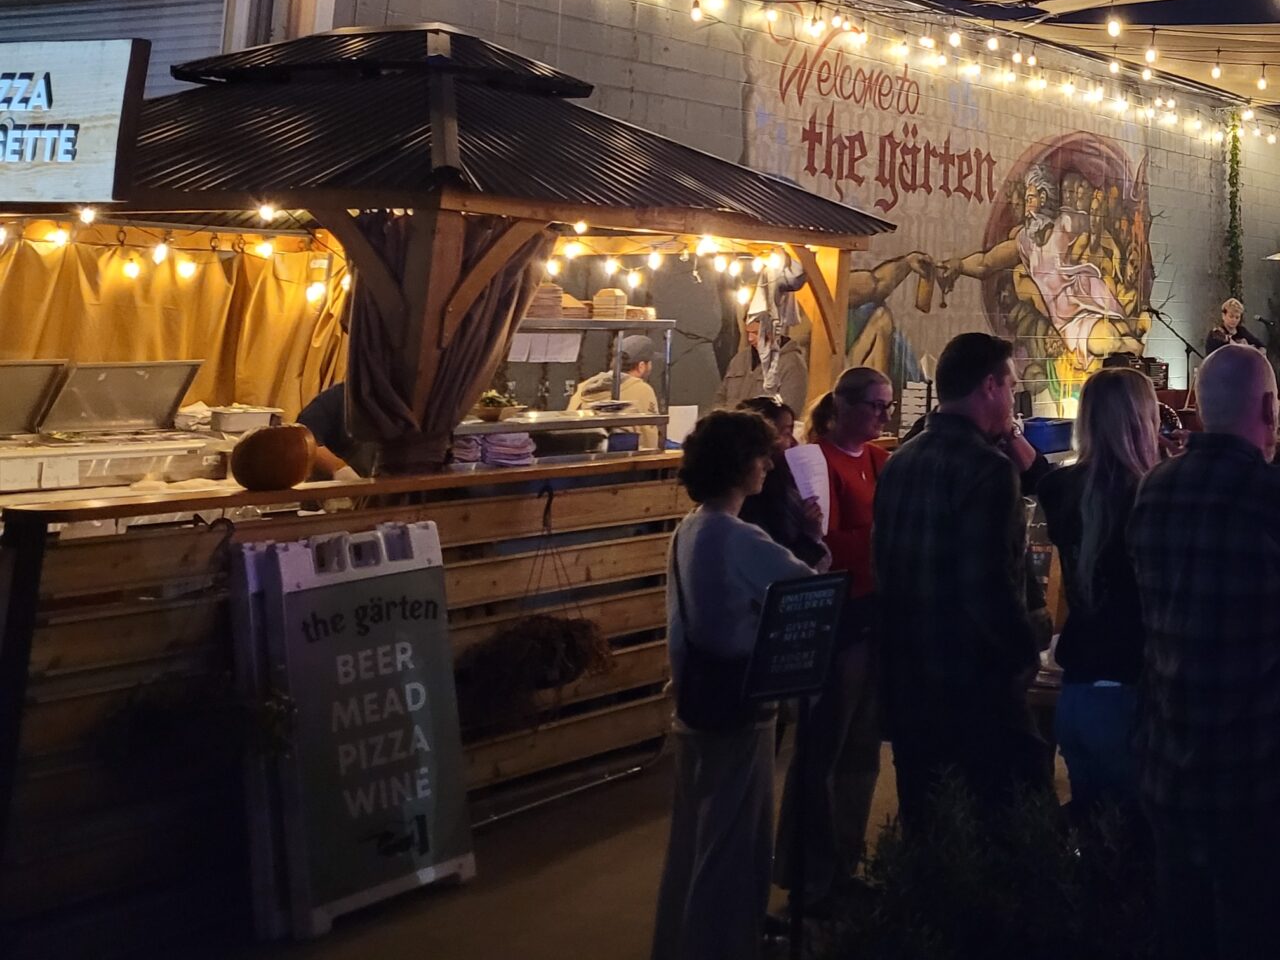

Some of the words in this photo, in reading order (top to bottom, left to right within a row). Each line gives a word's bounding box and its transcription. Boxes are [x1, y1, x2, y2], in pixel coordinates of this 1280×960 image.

[768, 24, 893, 110] Welcome
[802, 102, 867, 201] the
[874, 122, 997, 213] gärten
[302, 611, 345, 643] the
[355, 596, 439, 637] gärten
[336, 641, 415, 685] BEER
[332, 681, 427, 732] MEAD
[338, 724, 431, 776] PIZZA
[343, 766, 432, 821] WINE
